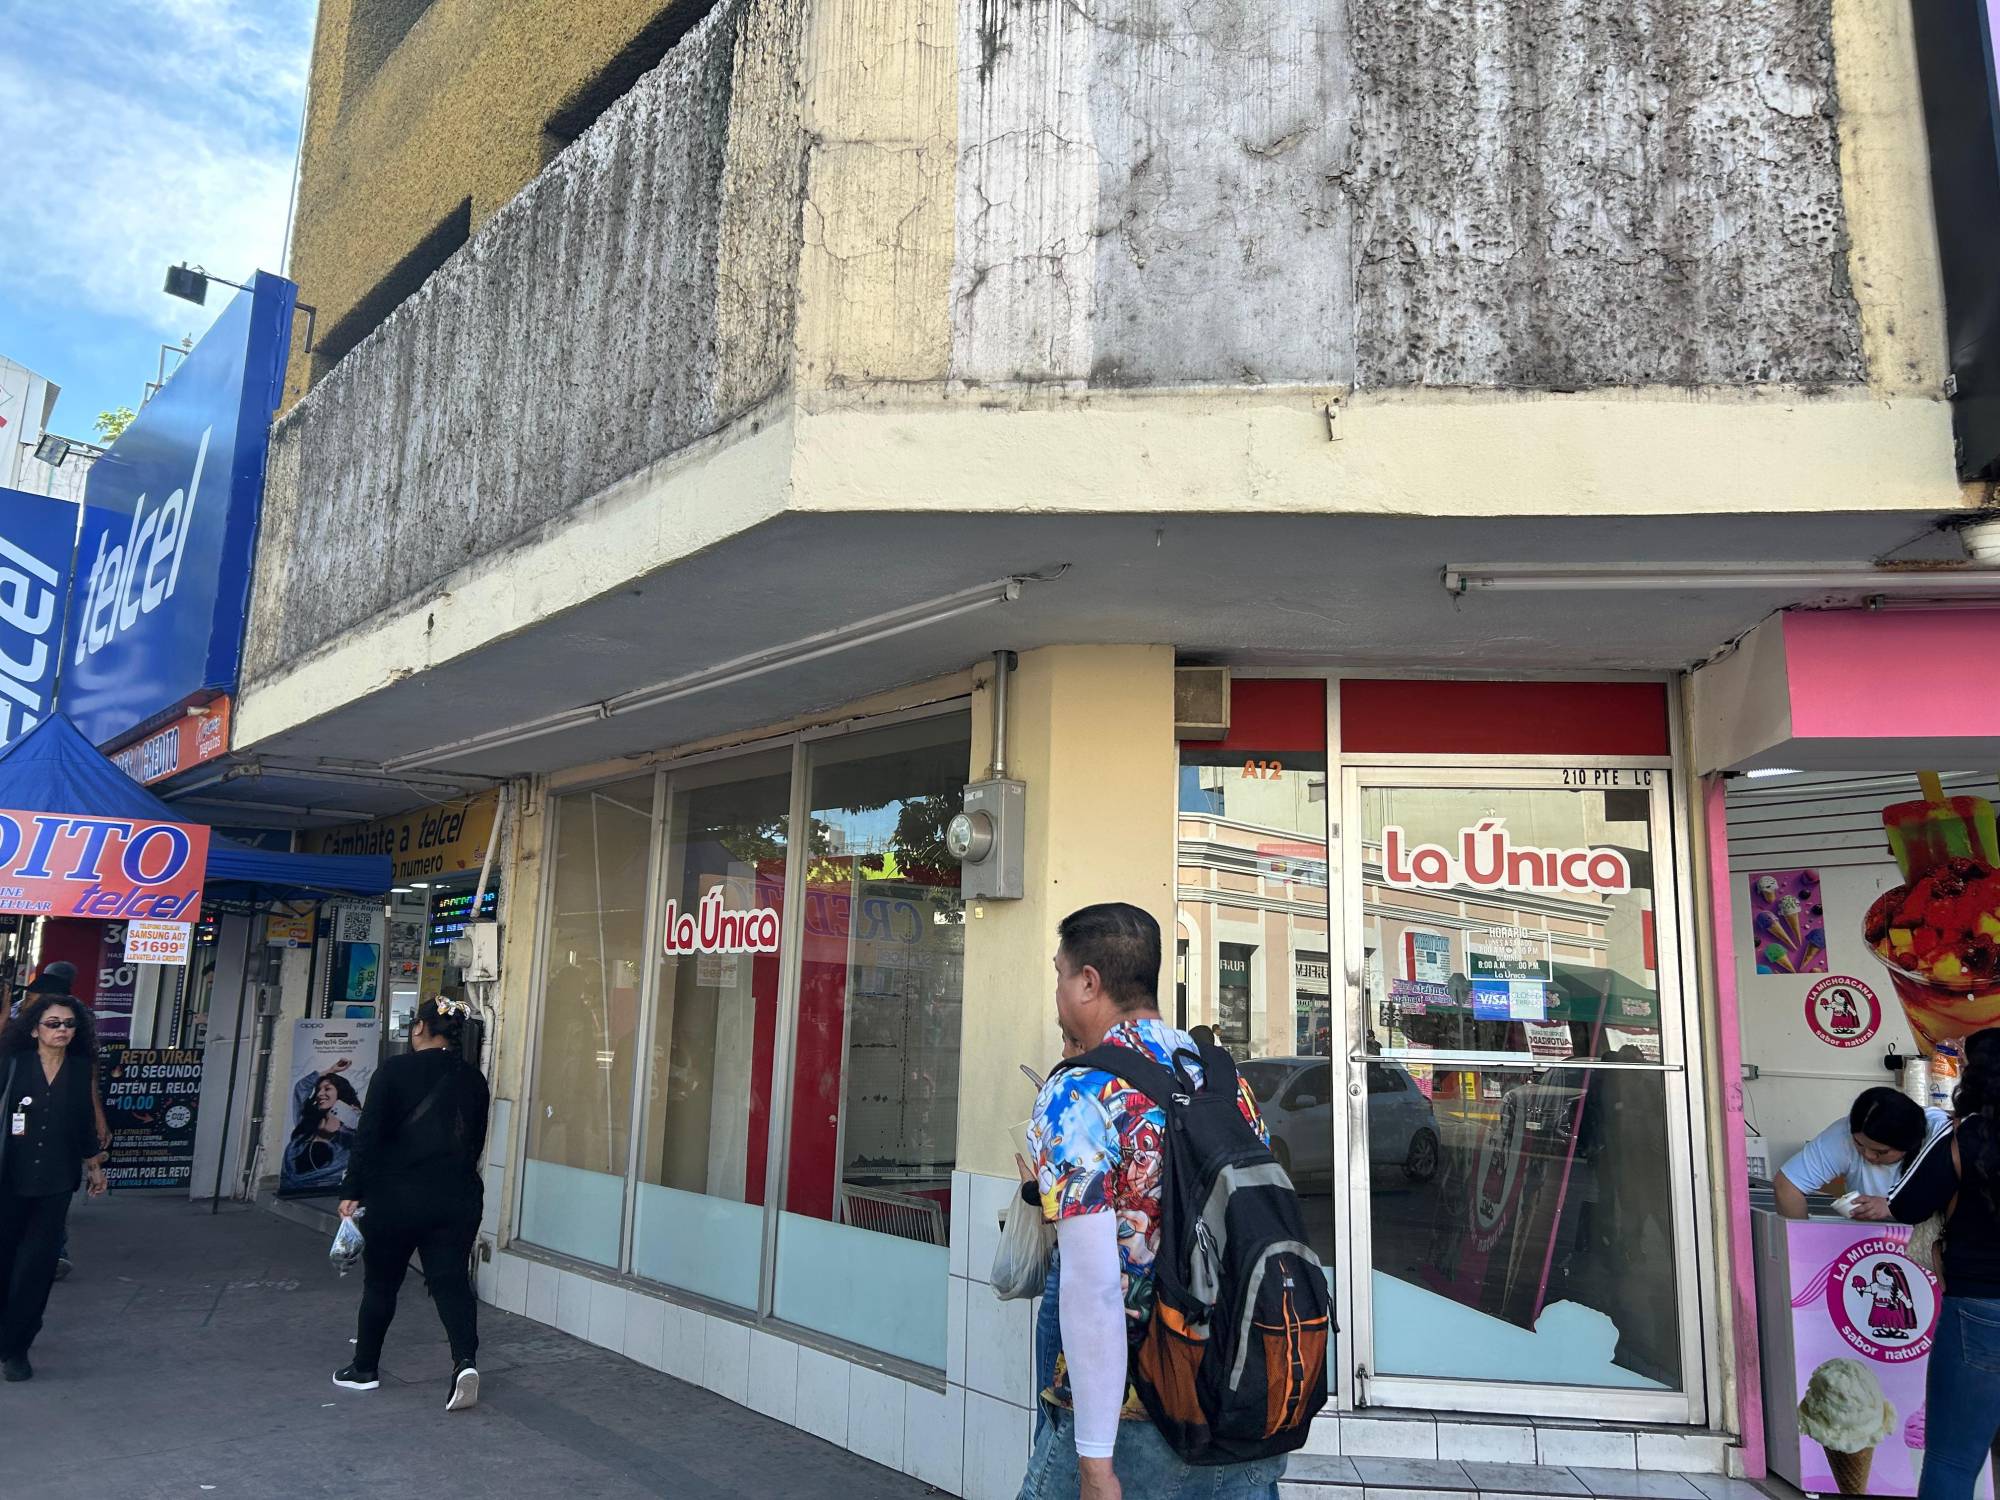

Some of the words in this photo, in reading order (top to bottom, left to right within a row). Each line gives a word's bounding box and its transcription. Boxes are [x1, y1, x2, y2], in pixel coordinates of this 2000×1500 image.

[75, 424, 213, 666] telcel
[1241, 760, 1283, 781] A12
[1562, 769, 1587, 785] 210
[1594, 769, 1619, 786] PTE
[400, 825, 410, 852] a
[417, 804, 468, 850] telcel
[1384, 828, 1450, 886] La
[1461, 819, 1627, 890] Única
[71, 884, 199, 920] telcel
[665, 902, 694, 951] La
[699, 888, 779, 951] Única
[129, 929, 170, 940] SAMSUNG
[1489, 927, 1528, 938] HORARIO
[129, 940, 178, 954] $1699
[1494, 970, 1504, 978] La
[1808, 990, 1819, 1001] LA
[1816, 977, 1874, 1000] MICHOACANA
[1480, 994, 1508, 1005] VISA
[1815, 1029, 1840, 1046] sabor
[1845, 1028, 1875, 1047] natural
[120, 1050, 157, 1065] RETO
[124, 1065, 138, 1078] 10
[141, 1065, 202, 1078] SEGUNDO
[149, 1083, 163, 1094] EL
[166, 1082, 200, 1094] RELOJ
[106, 1098, 116, 1106] EN
[116, 1095, 154, 1110] 10.00
[139, 1167, 156, 1178] POR
[157, 1167, 168, 1178] EL
[168, 1166, 190, 1178] RETO
[1832, 1262, 1851, 1282] LA
[1841, 1325, 1879, 1356] sabor
[1884, 1335, 1933, 1360] natural
